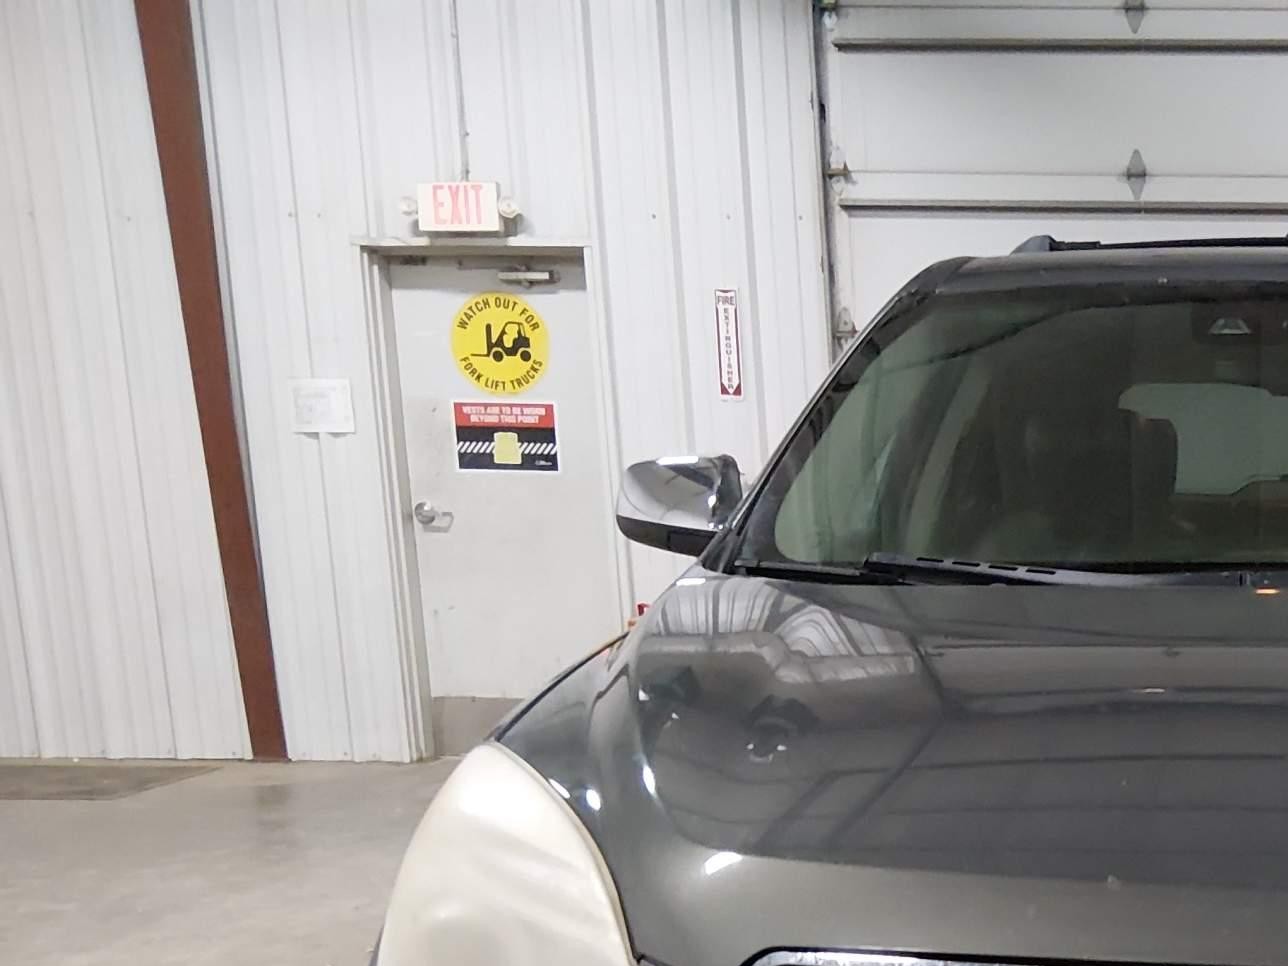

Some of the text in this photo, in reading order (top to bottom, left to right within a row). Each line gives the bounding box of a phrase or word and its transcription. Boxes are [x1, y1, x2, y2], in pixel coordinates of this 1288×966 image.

[432, 184, 483, 225] EXIT
[457, 297, 540, 332] WATCH OUT FOR
[717, 295, 735, 305] FIRE
[460, 356, 543, 392] FORK LIFT TRUCKS
